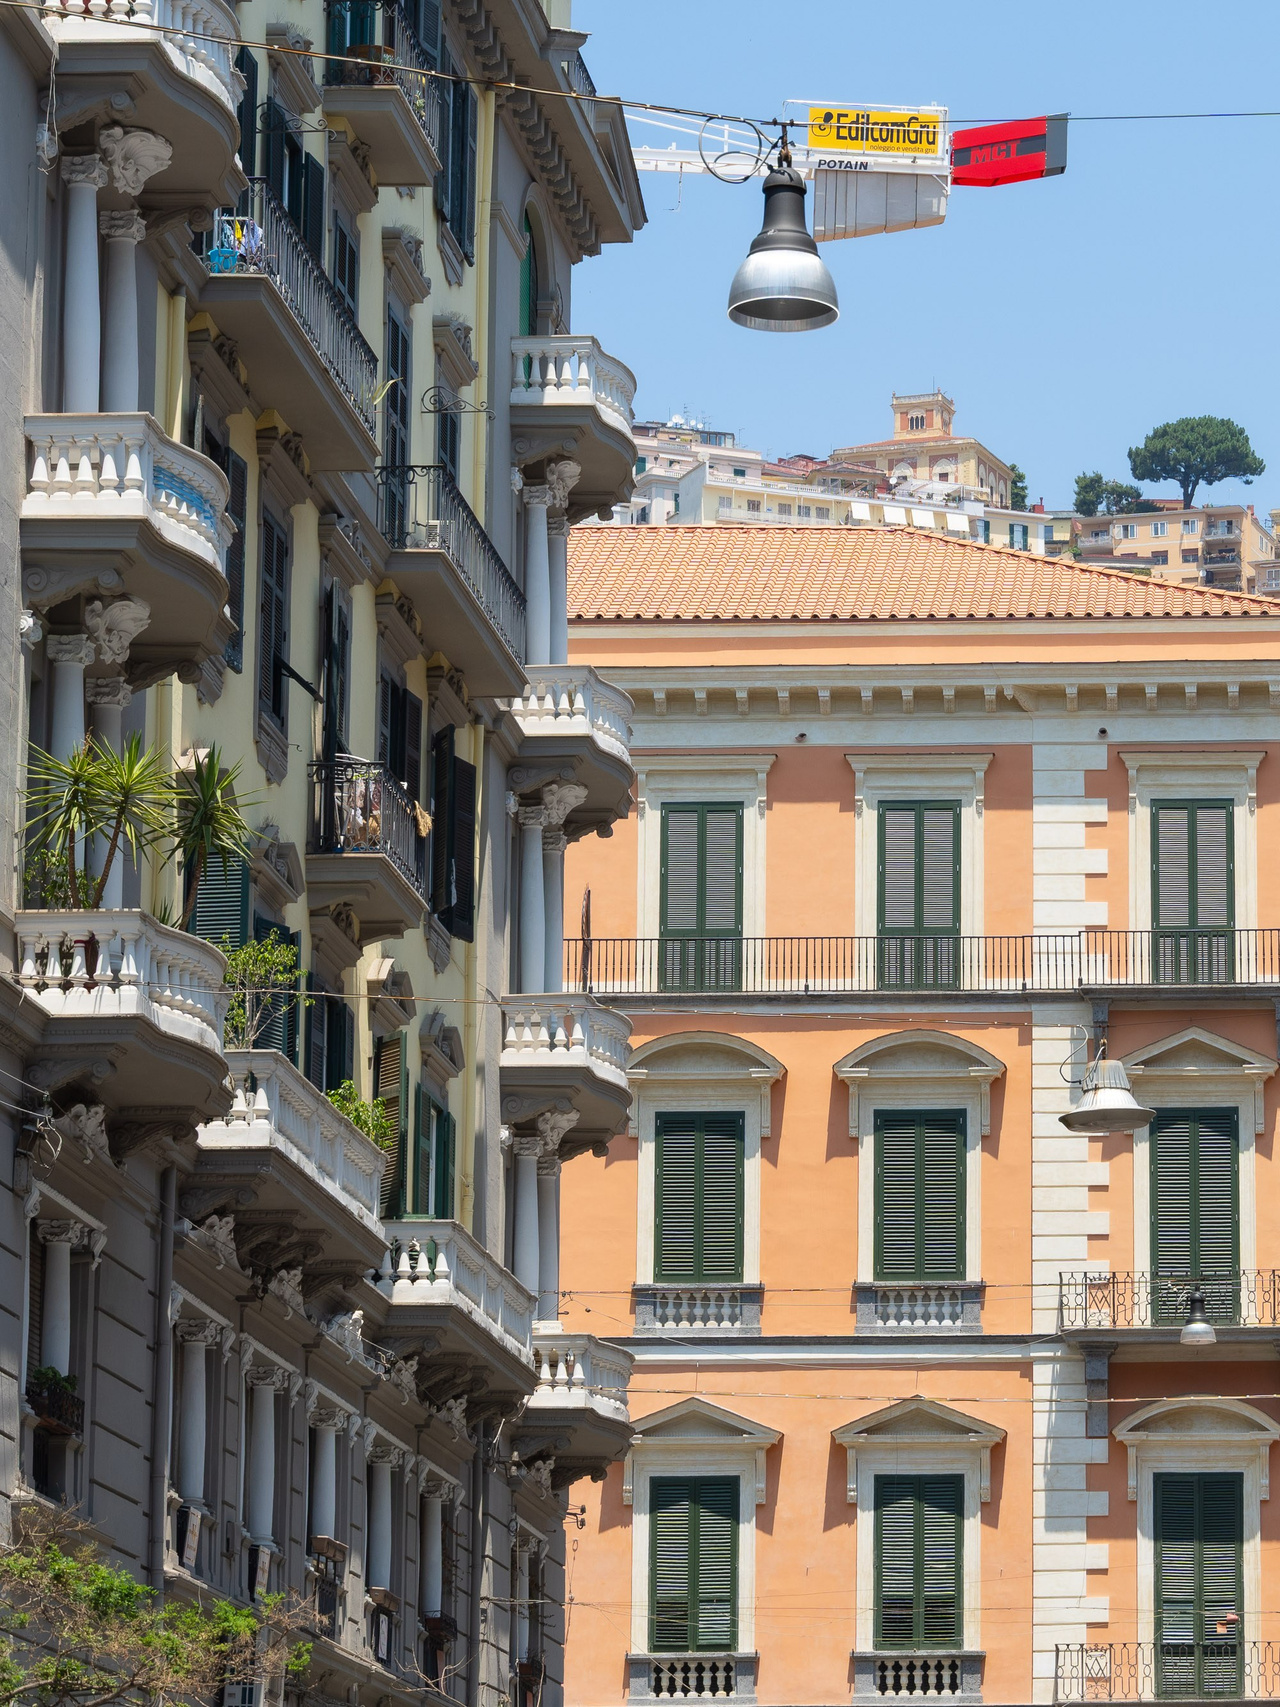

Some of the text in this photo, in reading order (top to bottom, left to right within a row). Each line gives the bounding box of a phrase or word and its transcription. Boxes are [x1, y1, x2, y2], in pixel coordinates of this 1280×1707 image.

[836, 113, 936, 145] EdilcomGru
[869, 144, 895, 152] noleggio
[970, 140, 1021, 165] MCT
[818, 159, 869, 171] POTAIN
